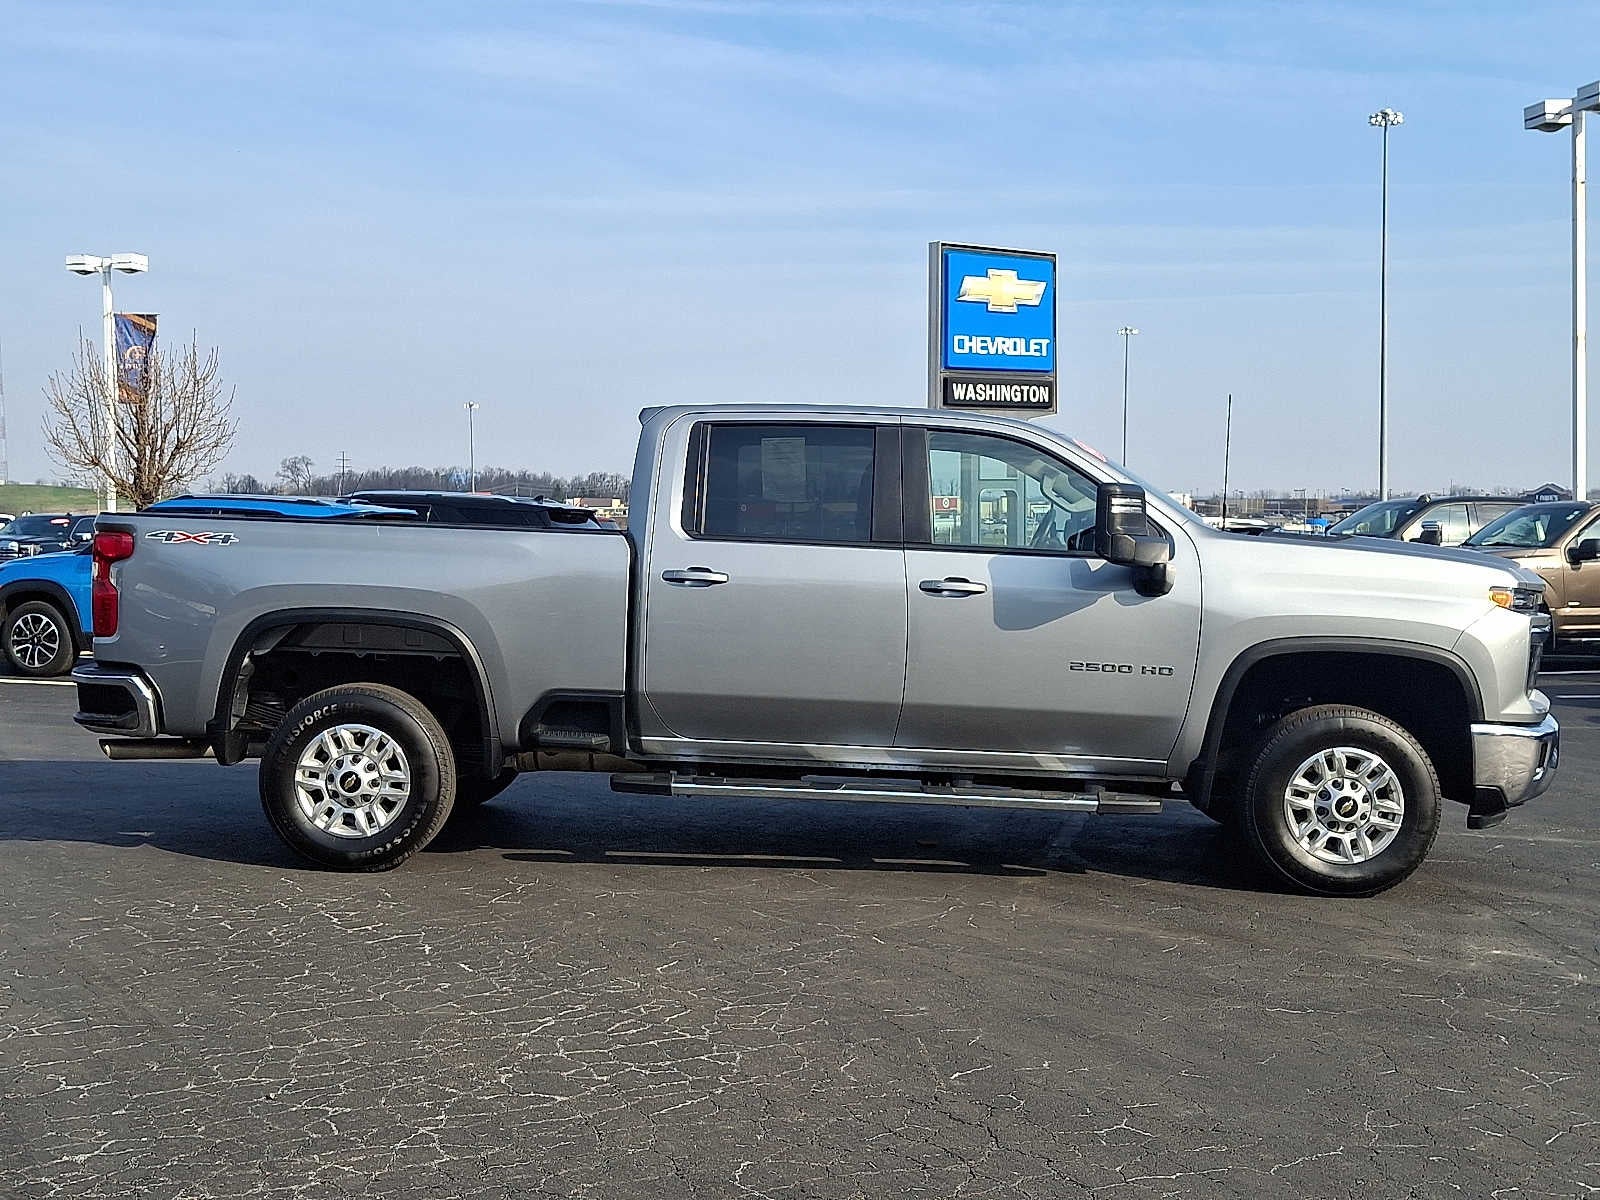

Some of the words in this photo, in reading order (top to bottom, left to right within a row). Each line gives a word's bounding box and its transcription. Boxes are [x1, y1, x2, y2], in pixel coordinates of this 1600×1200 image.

[953, 335, 1051, 357] CHEVROLET
[952, 383, 1049, 403] WASHINGTON
[1069, 661, 1133, 673] 2500
[1141, 665, 1174, 676] HD
